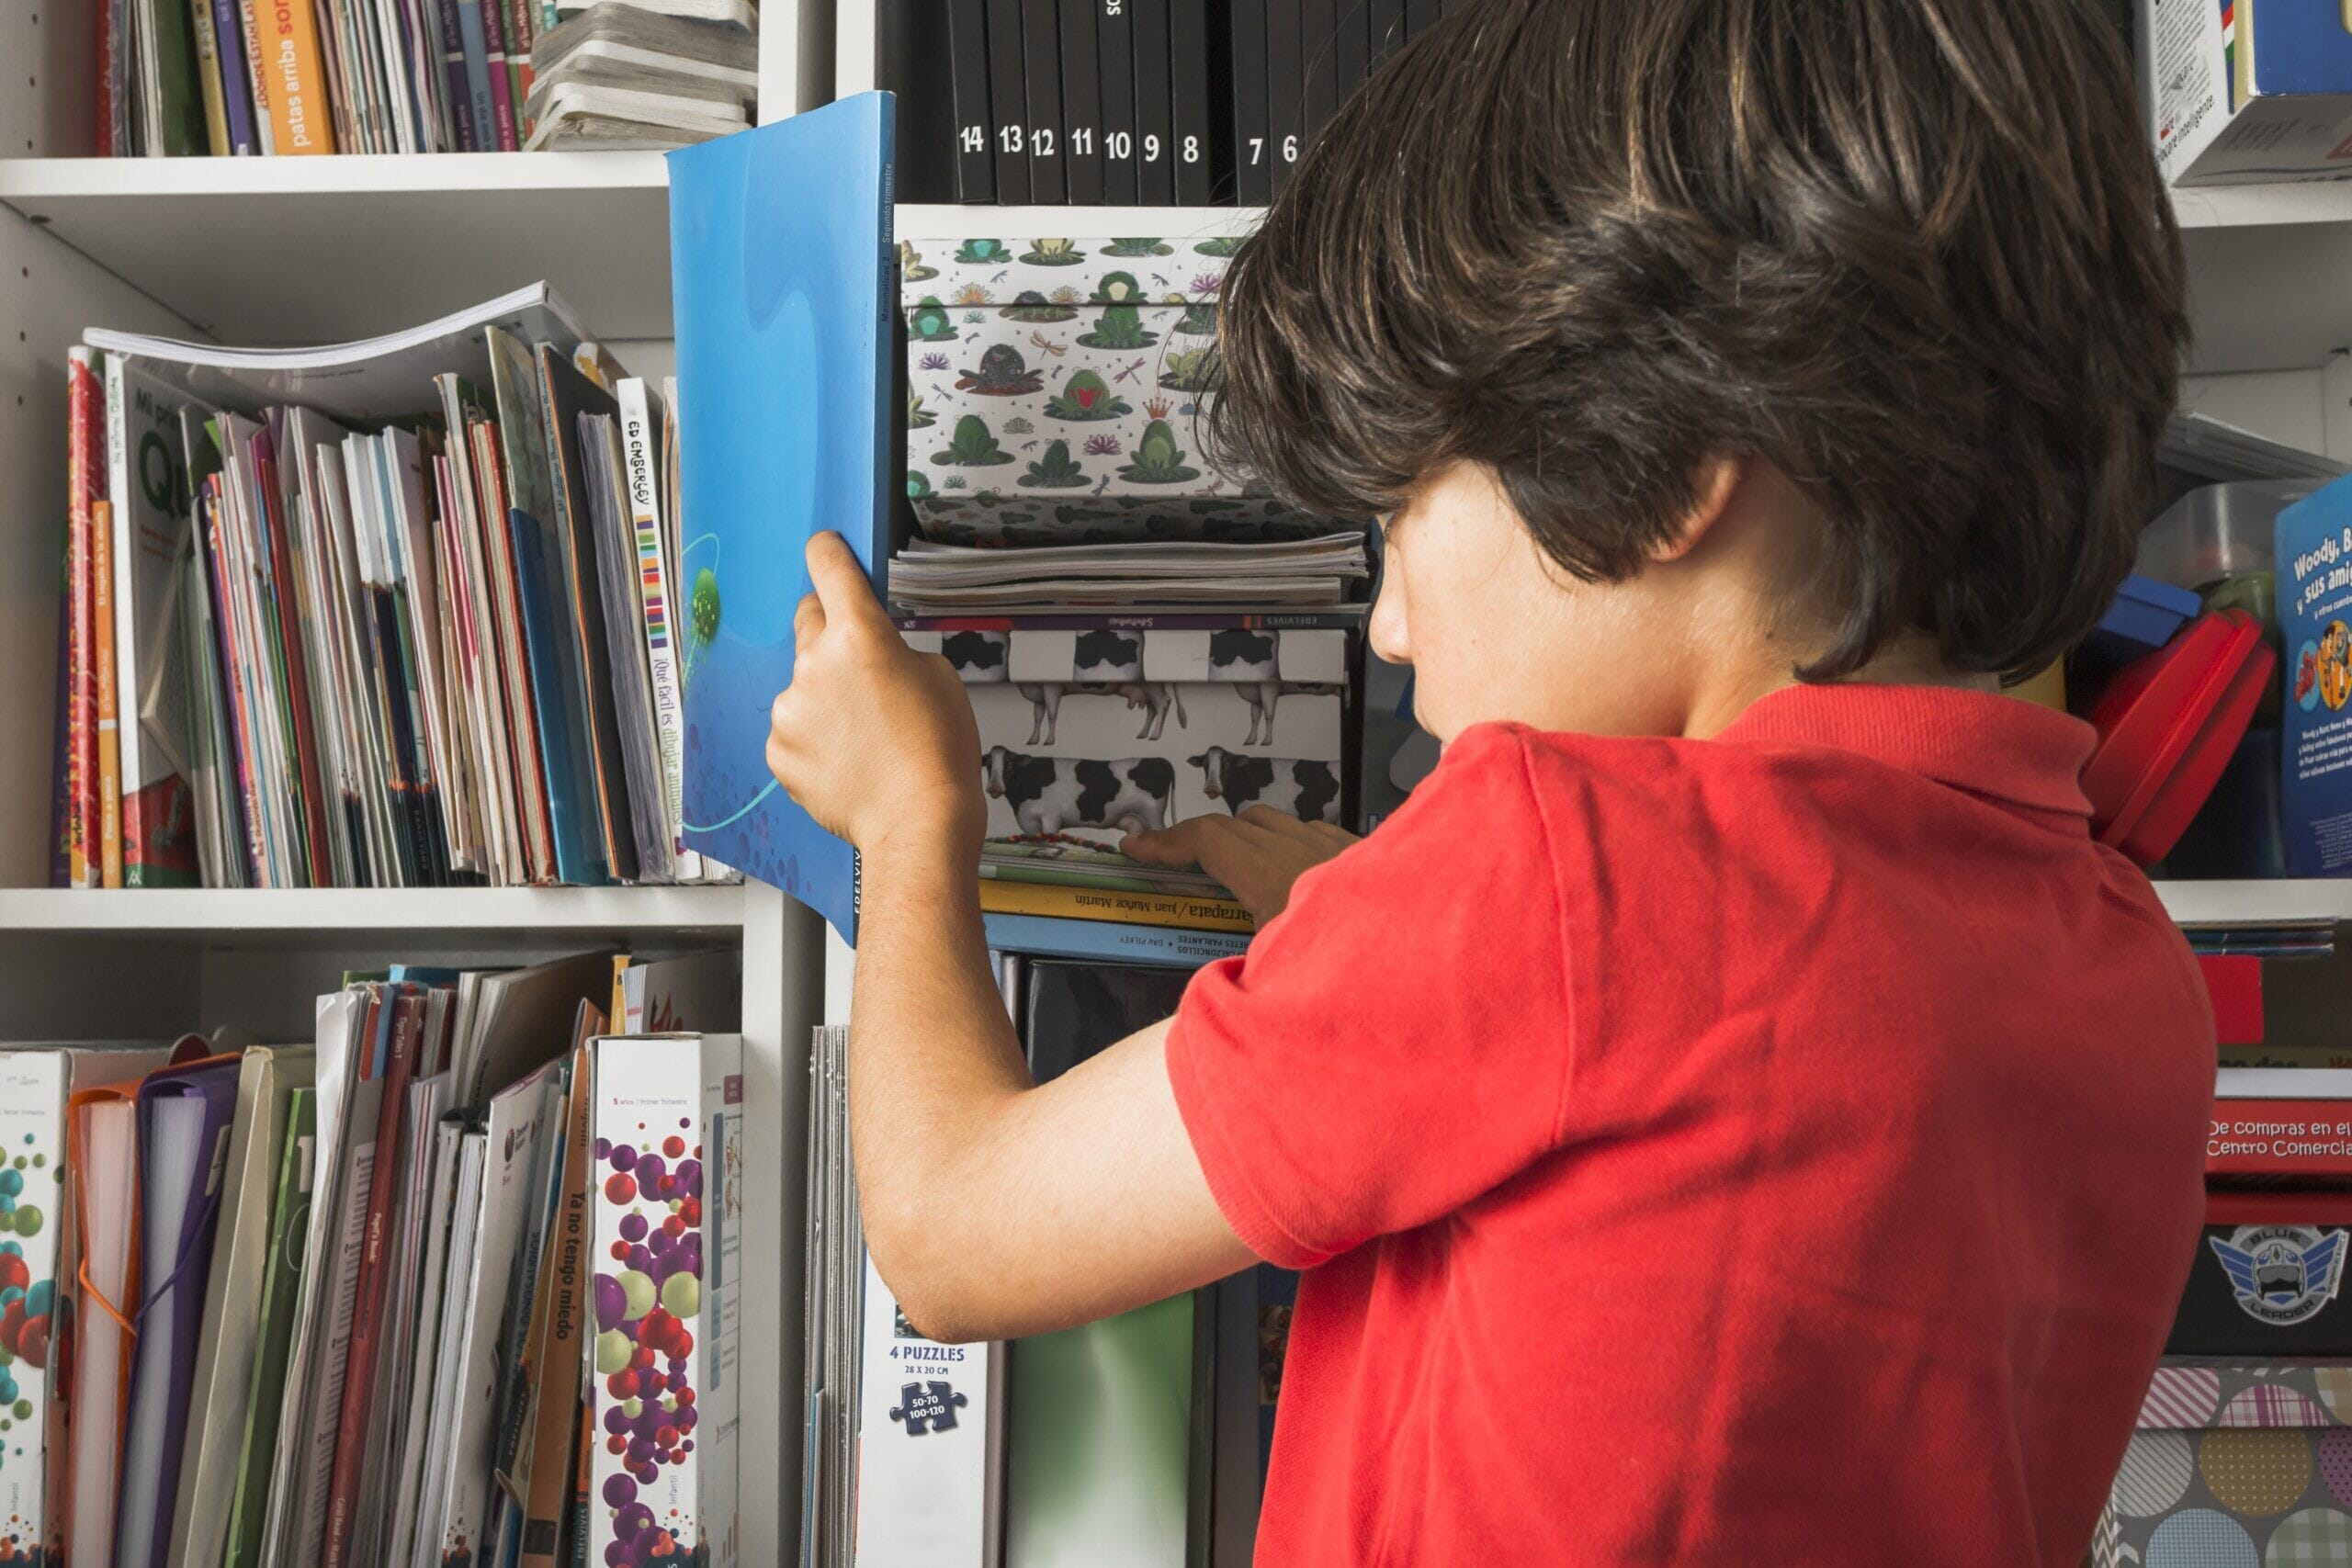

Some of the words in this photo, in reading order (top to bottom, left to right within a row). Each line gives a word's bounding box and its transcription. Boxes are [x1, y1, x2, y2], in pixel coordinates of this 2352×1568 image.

[277, 39, 300, 91] arriba
[288, 96, 311, 148] patas
[960, 126, 983, 152] 14
[1000, 125, 1023, 152] 13
[1031, 130, 1055, 156] 12
[1071, 129, 1091, 155] 11
[1104, 132, 1131, 160] 10
[1145, 134, 1159, 162] 9
[1183, 136, 1198, 164] 8
[1283, 136, 1297, 162] 6
[1250, 139, 1262, 165] 7
[882, 164, 893, 204] trimestre
[882, 206, 893, 243] Segundo
[628, 421, 639, 437] ED
[630, 440, 649, 505] EMBERLEY
[2294, 536, 2339, 581] Woody,
[2344, 527, 2352, 553] B
[2297, 598, 2302, 615] y
[2305, 576, 2324, 604] sus
[1266, 616, 1317, 625] EDELVIVES
[654, 658, 671, 683] ¡Qué
[658, 685, 674, 713] fácil
[662, 713, 673, 726] es
[662, 728, 678, 768] dibujar
[1075, 895, 1112, 909] Martín
[1115, 898, 1150, 913] Muñoz
[1154, 902, 1178, 915] Juan
[1119, 935, 1146, 944] PILKEY
[1178, 935, 1222, 946] PARLANTES
[397, 1016, 408, 1035] Tiger
[395, 1036, 405, 1053] Tales
[2234, 1119, 2306, 1141] compras
[2312, 1122, 2331, 1135] en
[2337, 1121, 2351, 1137] el
[2207, 1141, 2267, 1156] Centro
[570, 1192, 586, 1209] Ya
[568, 1213, 582, 1233] no
[2249, 1227, 2301, 1244] BLUE
[559, 1238, 581, 1284] tengo
[556, 1290, 578, 1341] miedo
[2251, 1299, 2315, 1319] LEADER
[889, 1347, 899, 1359] 4
[904, 1347, 965, 1361] PUZZLES
[910, 1405, 944, 1418] 100-120
[912, 1396, 938, 1407] 50-70
[669, 1475, 678, 1505] Infantil
[577, 1507, 588, 1559] EDELVIVES
